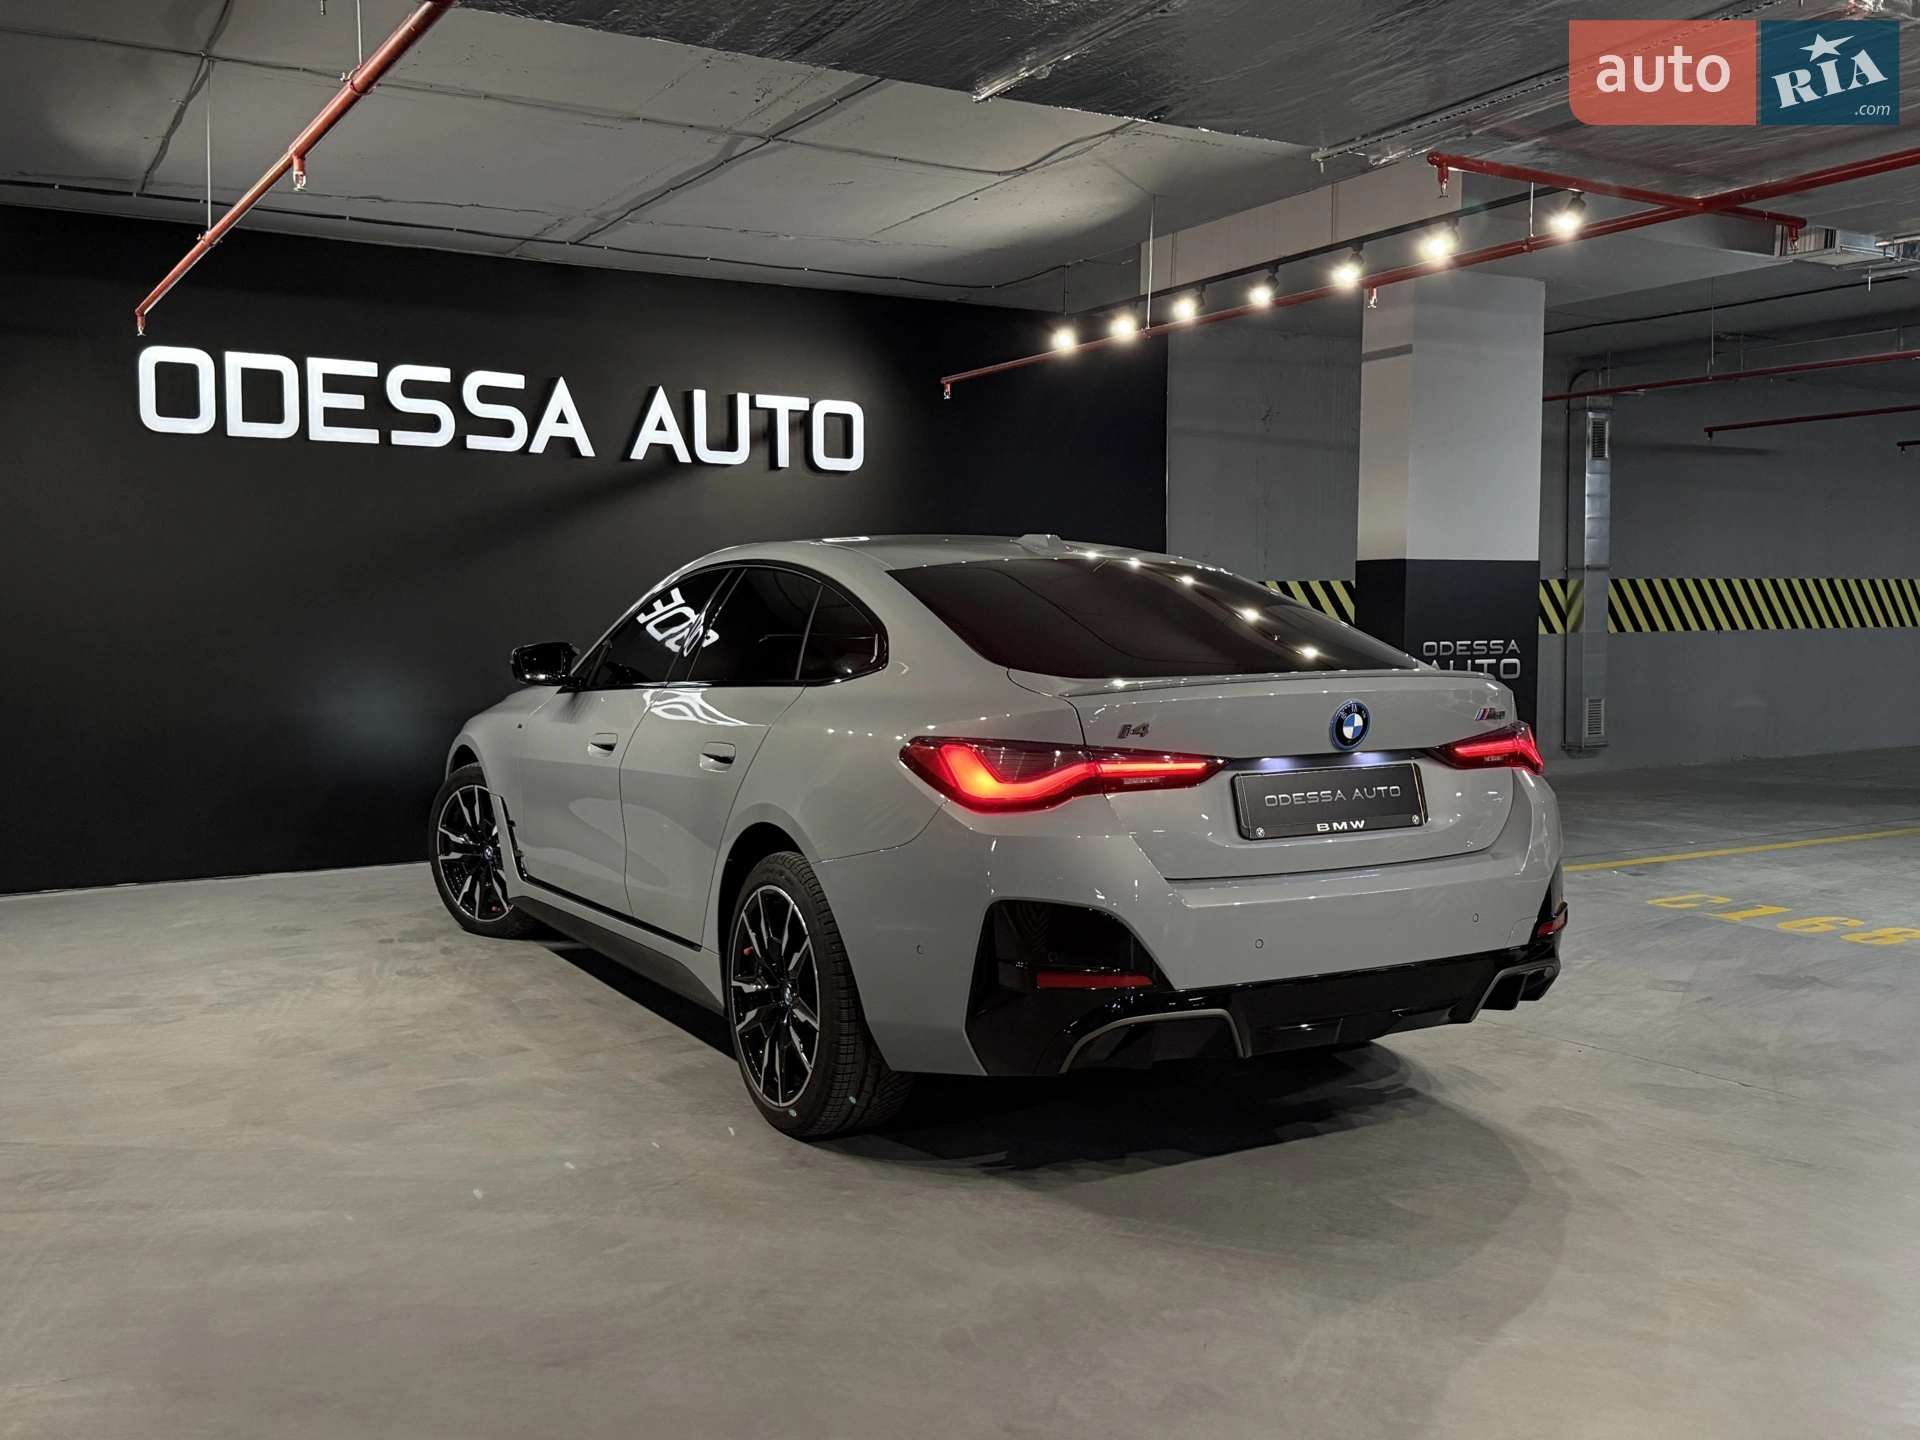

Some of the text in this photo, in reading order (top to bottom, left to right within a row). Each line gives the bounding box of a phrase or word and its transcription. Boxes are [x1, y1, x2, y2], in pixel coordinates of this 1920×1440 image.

[138, 345, 865, 471] ODESSA AUTO
[1423, 639, 1521, 657] ODESSA
[1264, 785, 1401, 807] ODESSA AUTO
[1316, 819, 1366, 832] BMW
